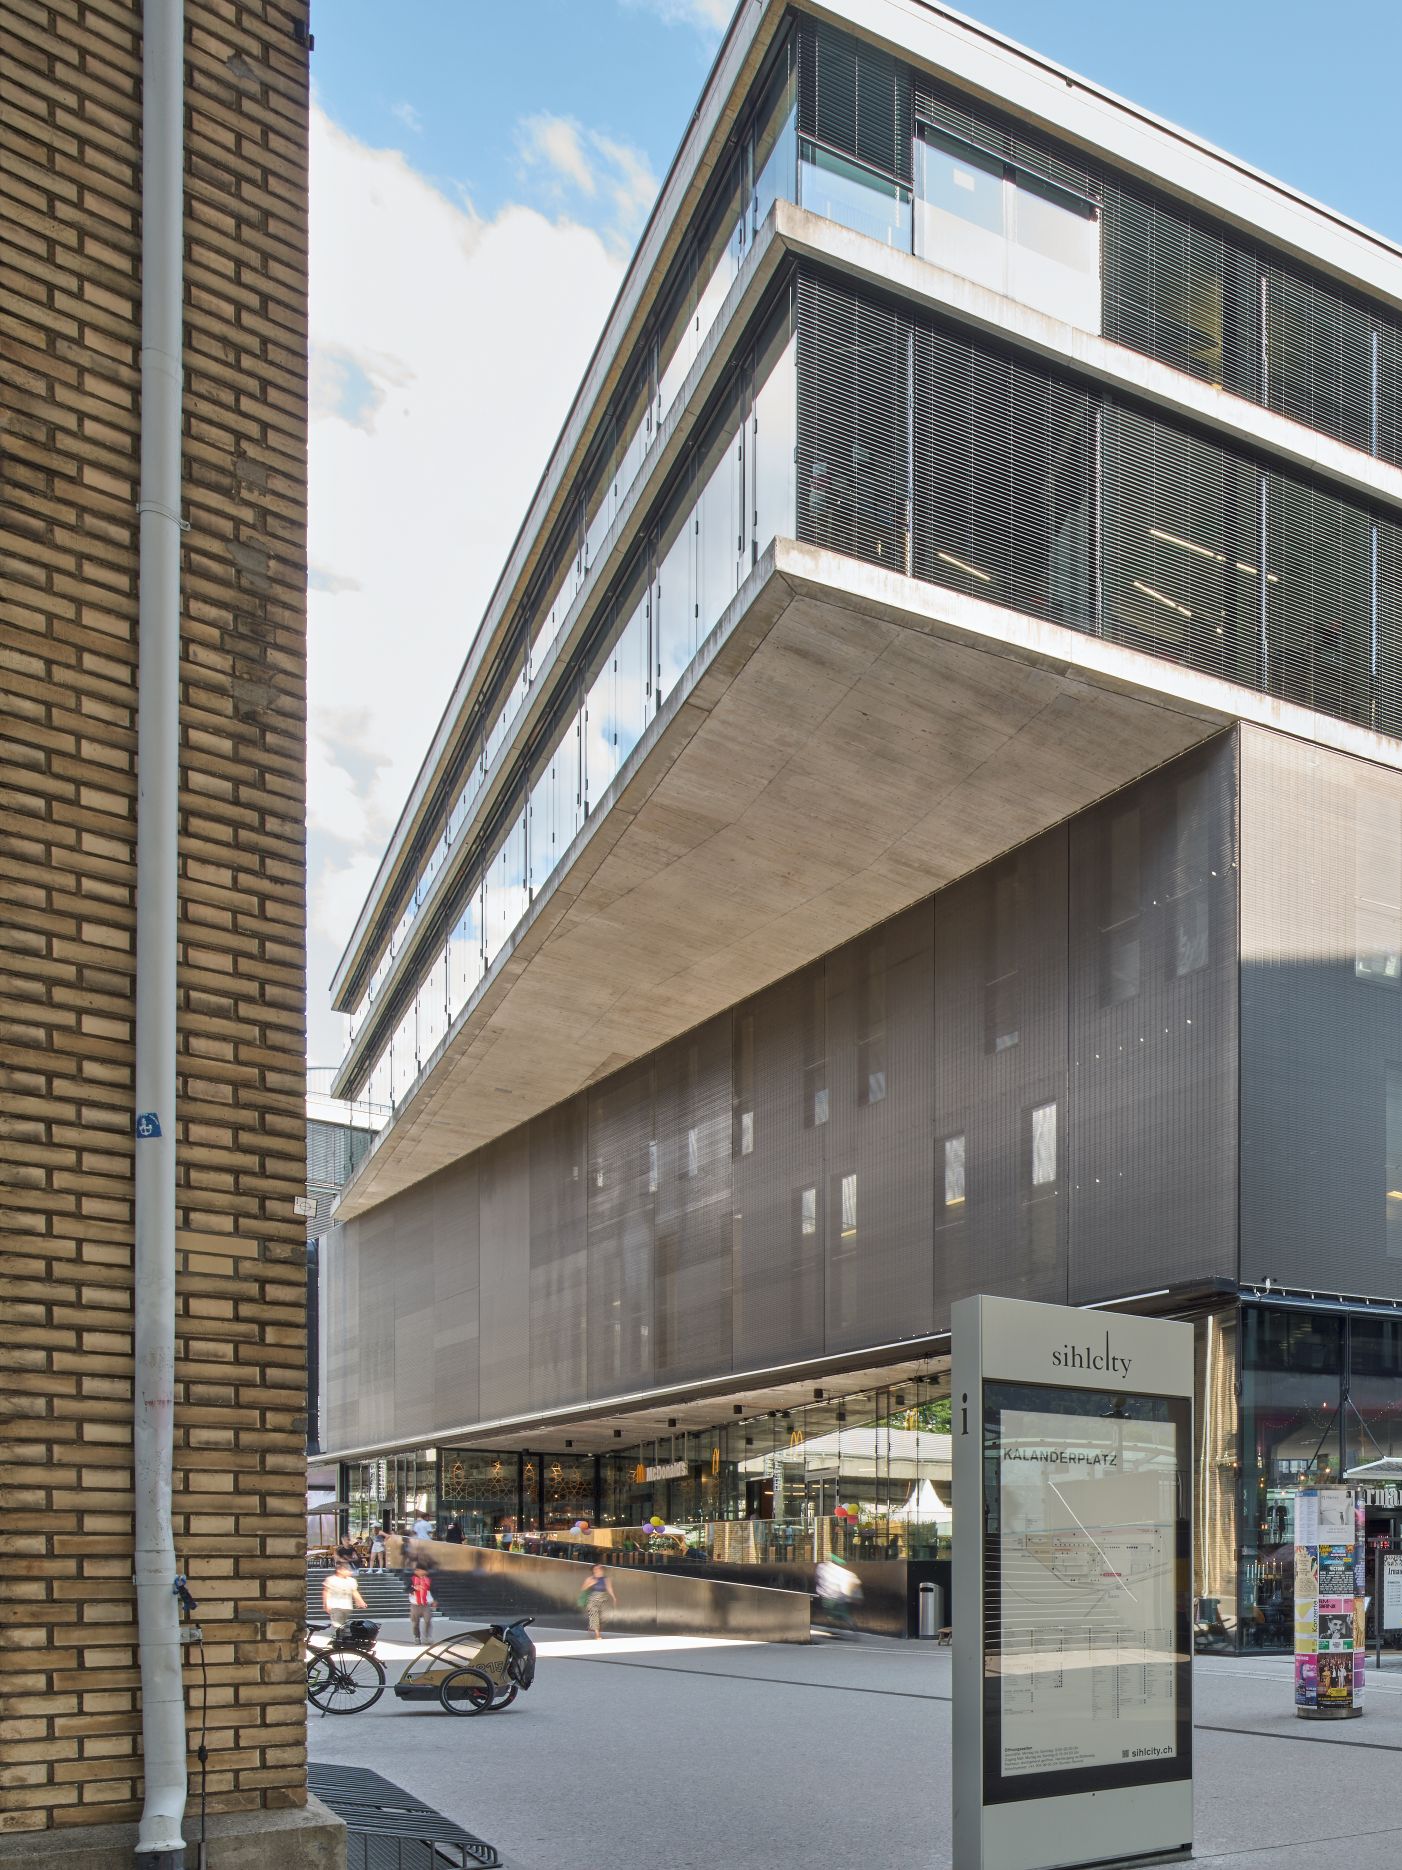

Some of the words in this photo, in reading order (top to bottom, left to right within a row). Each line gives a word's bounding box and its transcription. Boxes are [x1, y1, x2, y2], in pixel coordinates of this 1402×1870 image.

[1052, 1330, 1132, 1378] sihlcity
[961, 1393, 968, 1435] i
[1003, 1447, 1117, 1466] KALANDERPLATZ
[1131, 1745, 1173, 1758] sihlcity.ch
